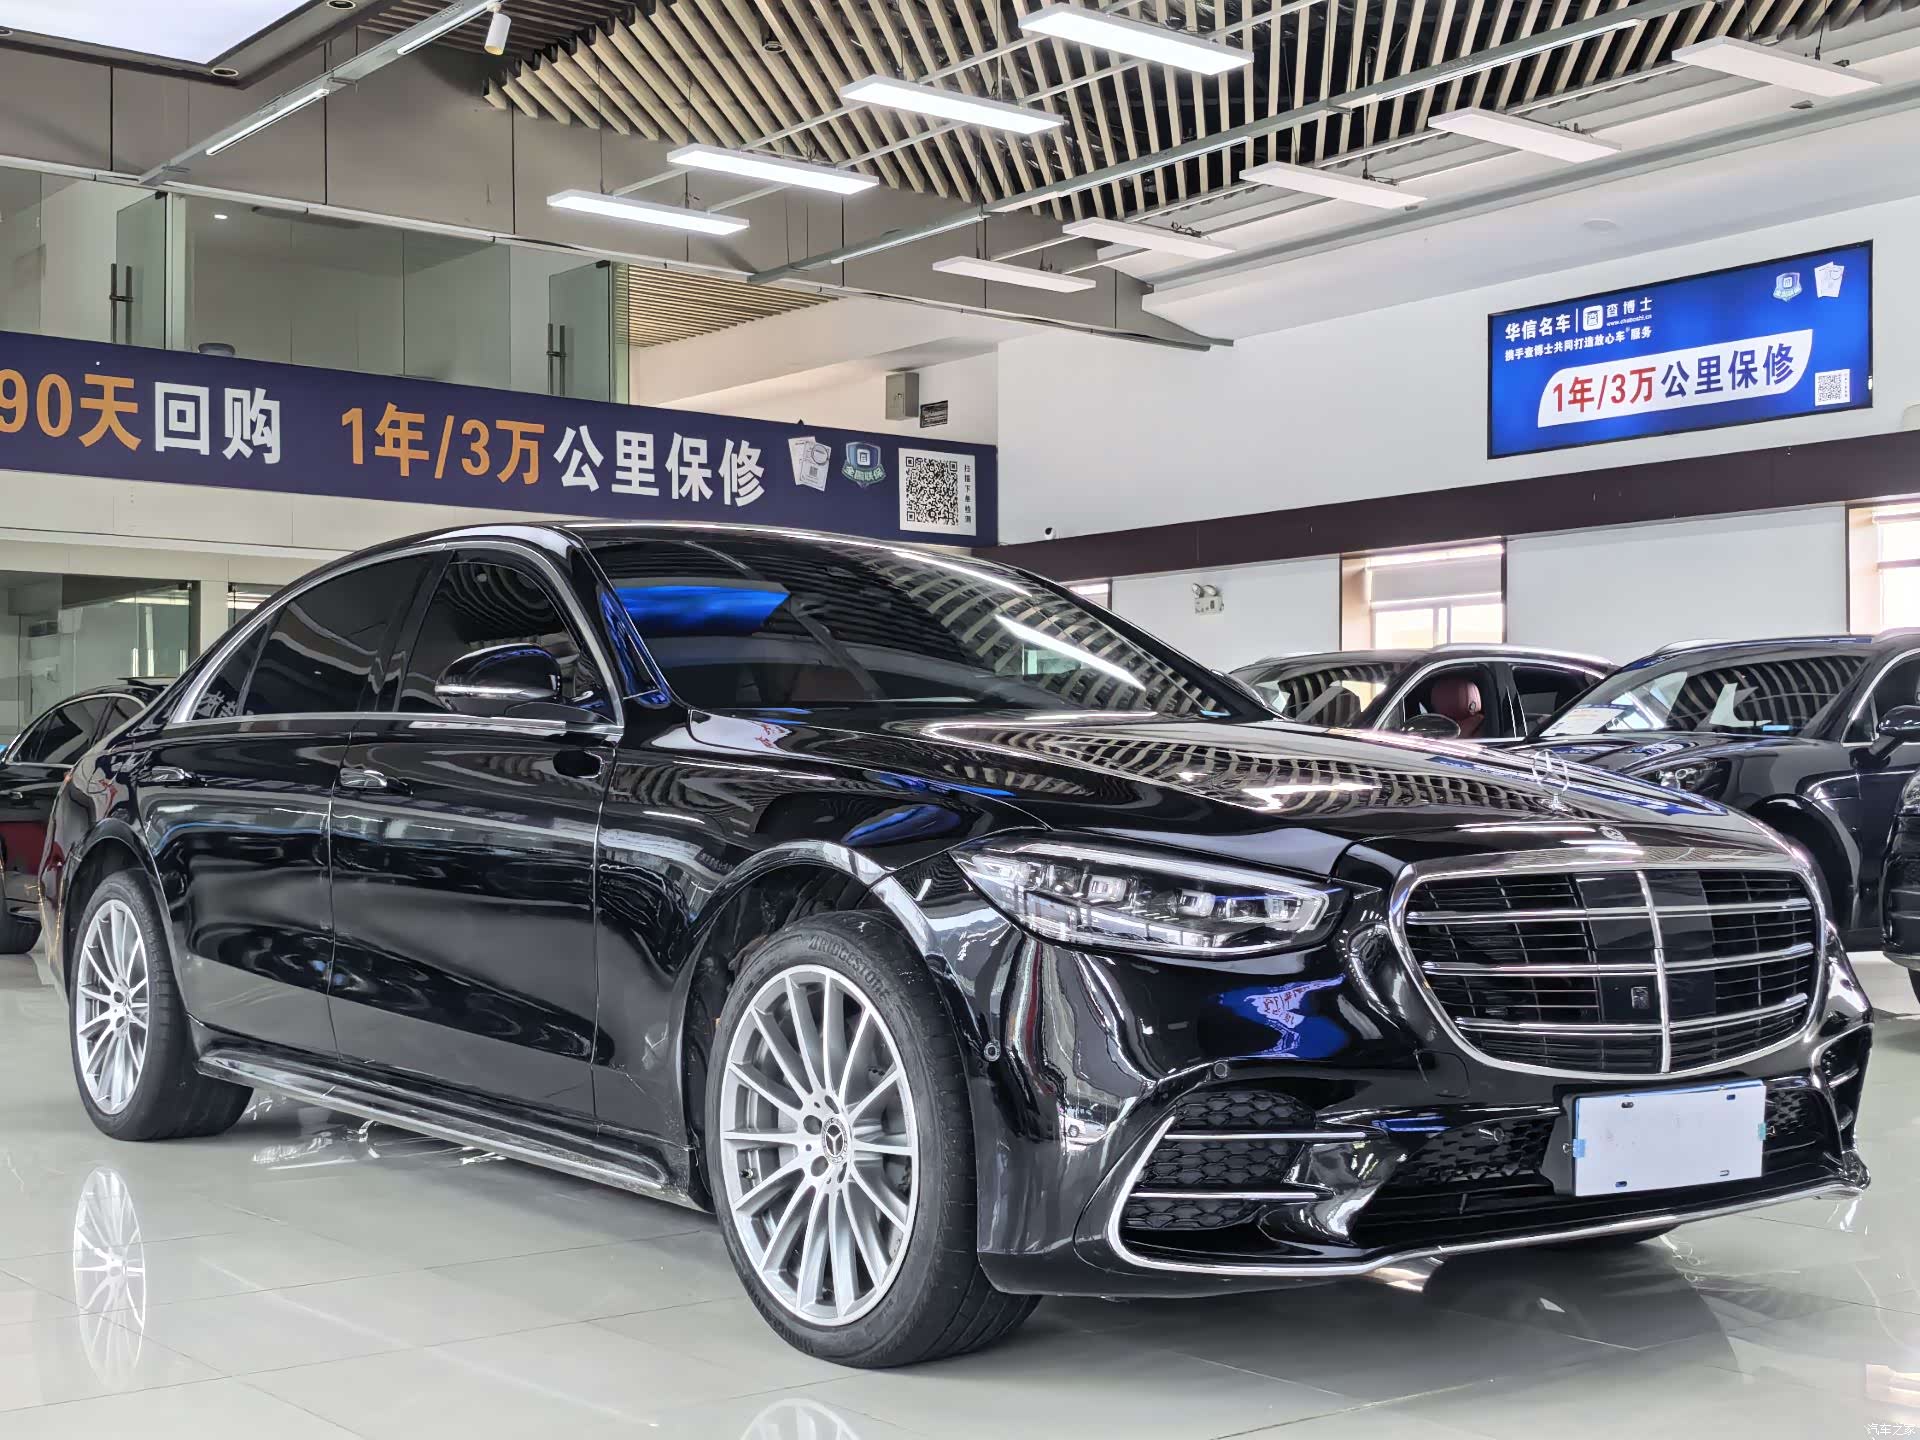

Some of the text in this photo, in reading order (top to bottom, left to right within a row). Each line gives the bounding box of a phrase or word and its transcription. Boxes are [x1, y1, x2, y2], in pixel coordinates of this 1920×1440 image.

[1505, 303, 1571, 342] 华信名车
[1606, 297, 1653, 318] 查博士
[1552, 342, 1795, 413] 1年/3万公里保修
[0, 368, 765, 507] 90天回购 1年/3万公里保修
